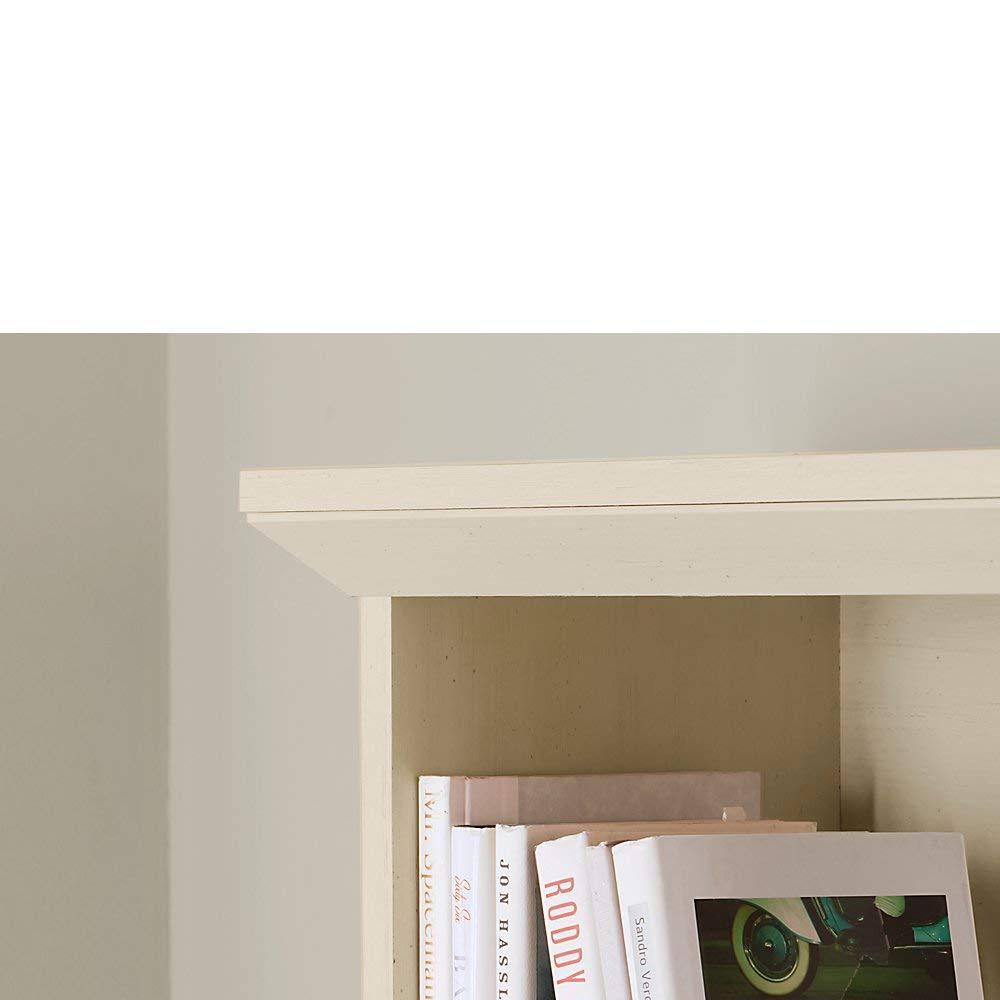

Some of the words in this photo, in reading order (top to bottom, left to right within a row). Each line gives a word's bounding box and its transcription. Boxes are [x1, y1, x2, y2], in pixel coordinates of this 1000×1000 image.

[499, 859, 509, 905] JON
[421, 851, 439, 1000] Spaceman
[544, 877, 586, 985] RODDY
[634, 917, 649, 966] Sandro
